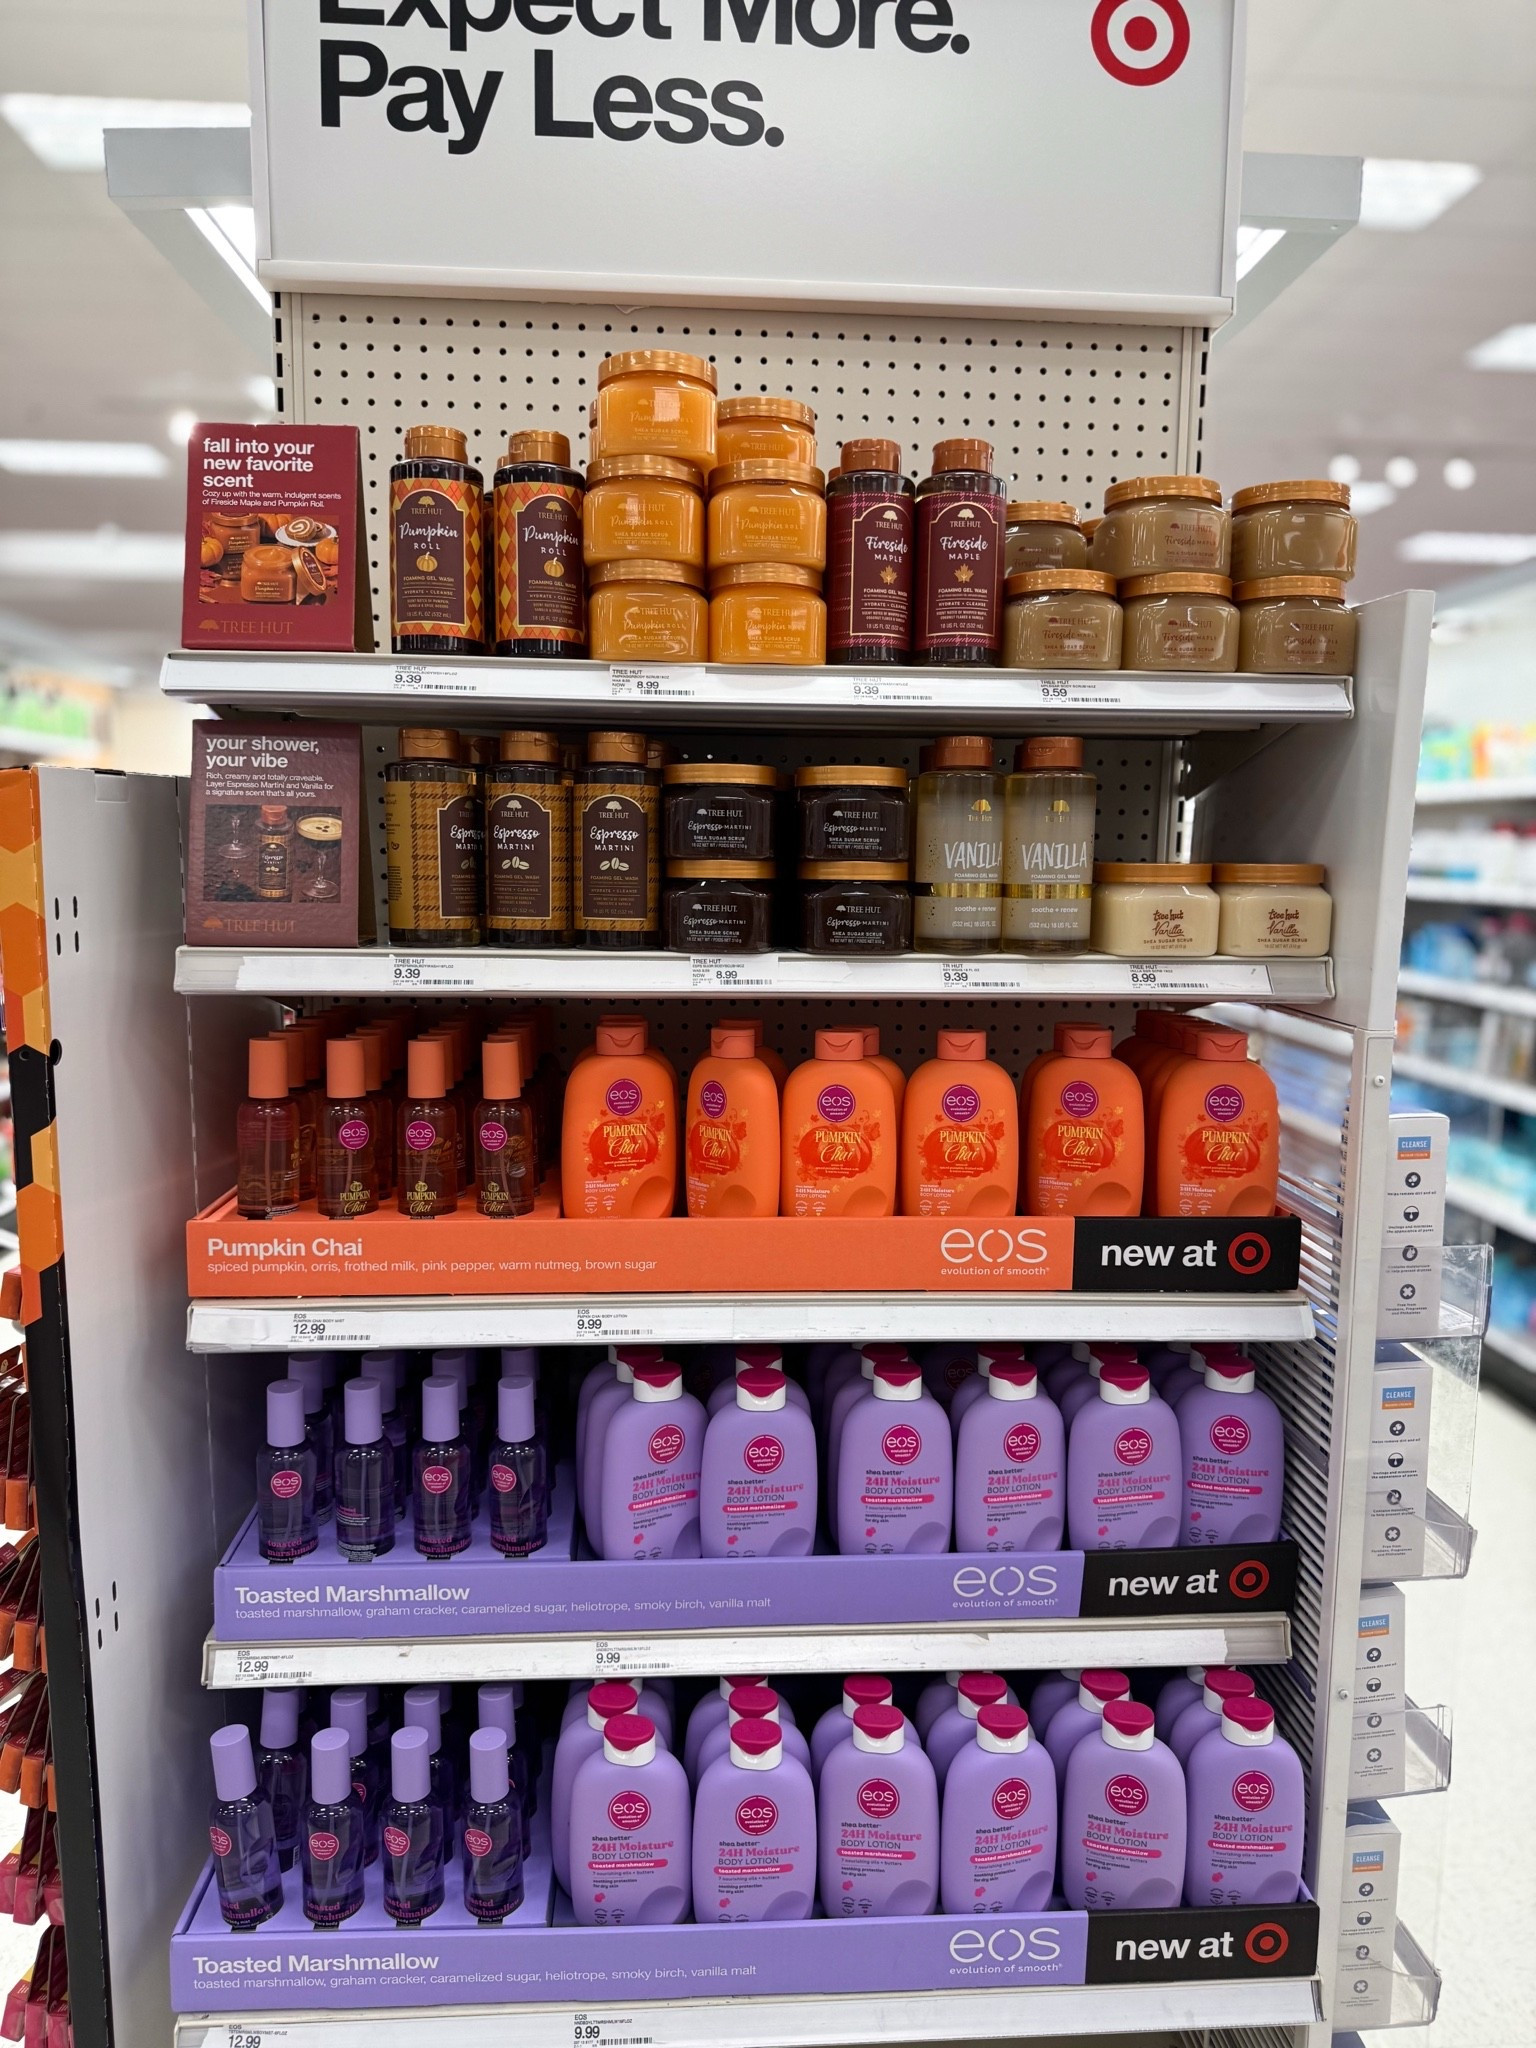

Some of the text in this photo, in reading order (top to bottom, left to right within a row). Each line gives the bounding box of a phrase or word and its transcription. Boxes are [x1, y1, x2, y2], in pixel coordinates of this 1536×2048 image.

[320, 39, 785, 155] Pay Less.
[203, 438, 314, 458] fall into your
[203, 456, 314, 472] new favorite
[202, 474, 254, 488] scent
[202, 490, 220, 498] Cozy
[233, 490, 248, 498] with
[284, 492, 316, 500] indulgent
[210, 498, 238, 506] Fireside
[240, 499, 262, 507] Maple
[278, 500, 308, 508] Pumpkin
[310, 500, 324, 508] Roll.
[950, 520, 981, 528] TREE HUT
[399, 522, 458, 542] Pumpkin
[414, 542, 440, 550] ROLL
[940, 534, 988, 552] Fireside
[220, 620, 293, 634] TREE HUT
[394, 674, 422, 684] 9.39
[637, 681, 659, 689] 8.99
[206, 736, 320, 754] your shower,
[206, 753, 288, 769] your vibe
[206, 772, 223, 780] Rich,
[267, 774, 288, 782] totally
[226, 781, 259, 789] Espresso
[212, 789, 244, 797] signature
[688, 821, 723, 833] Espresso
[590, 826, 640, 844] Espresso
[1022, 842, 1088, 870] VANILLA
[1268, 909, 1300, 920] tree hut
[1267, 920, 1300, 937] Vanilla
[394, 968, 420, 978] 9.39
[716, 971, 737, 979] 8.99
[944, 972, 968, 982] 9.39
[1131, 973, 1156, 983] 8.99
[946, 1096, 976, 1106] eos
[940, 1130, 986, 1143] PUMPKIN
[1401, 1140, 1428, 1148] CLEANSE
[945, 1144, 980, 1163] Chai
[207, 1238, 363, 1260] Pumpkin Chai
[940, 1228, 1048, 1264] eos
[1101, 1240, 1216, 1267] new at
[208, 1260, 657, 1274] spiced pumpkin, orris, frothed milk, pink pepper, warm nutmeg, brown sugar
[941, 1266, 1046, 1275] evolution of smooth
[294, 1324, 326, 1334] 12.99
[577, 1319, 602, 1329] 9.99
[886, 1437, 916, 1448] eos
[866, 1476, 940, 1486] 24H Moisture
[952, 1565, 1057, 1598] eos
[1108, 1569, 1219, 1596] new at
[234, 1584, 470, 1604] Toasted Marshmallow
[236, 1597, 771, 1619] toasted marshmallow, graham cracker, caramelized sugar, heliotrope, smoky birch, vanilla malt
[952, 1598, 1054, 1609] evolution of smooth
[596, 1652, 620, 1664] 9.99
[237, 1661, 269, 1672] 12.99
[1238, 1783, 1269, 1794] eos
[1214, 1822, 1292, 1833] 24H Moisture
[1212, 1832, 1238, 1840] BODY
[950, 1927, 1061, 1964] eos
[1115, 1932, 1234, 1961] new at
[192, 1953, 439, 1974] Toasted Marshmallow
[950, 1963, 1059, 1974] evolution of smooth
[194, 1966, 756, 1989] toasted marshmallow, graham cracker, caramelized sugar, heliotrope, smoky birch, vanilla malt
[574, 2026, 600, 2039] 9.99
